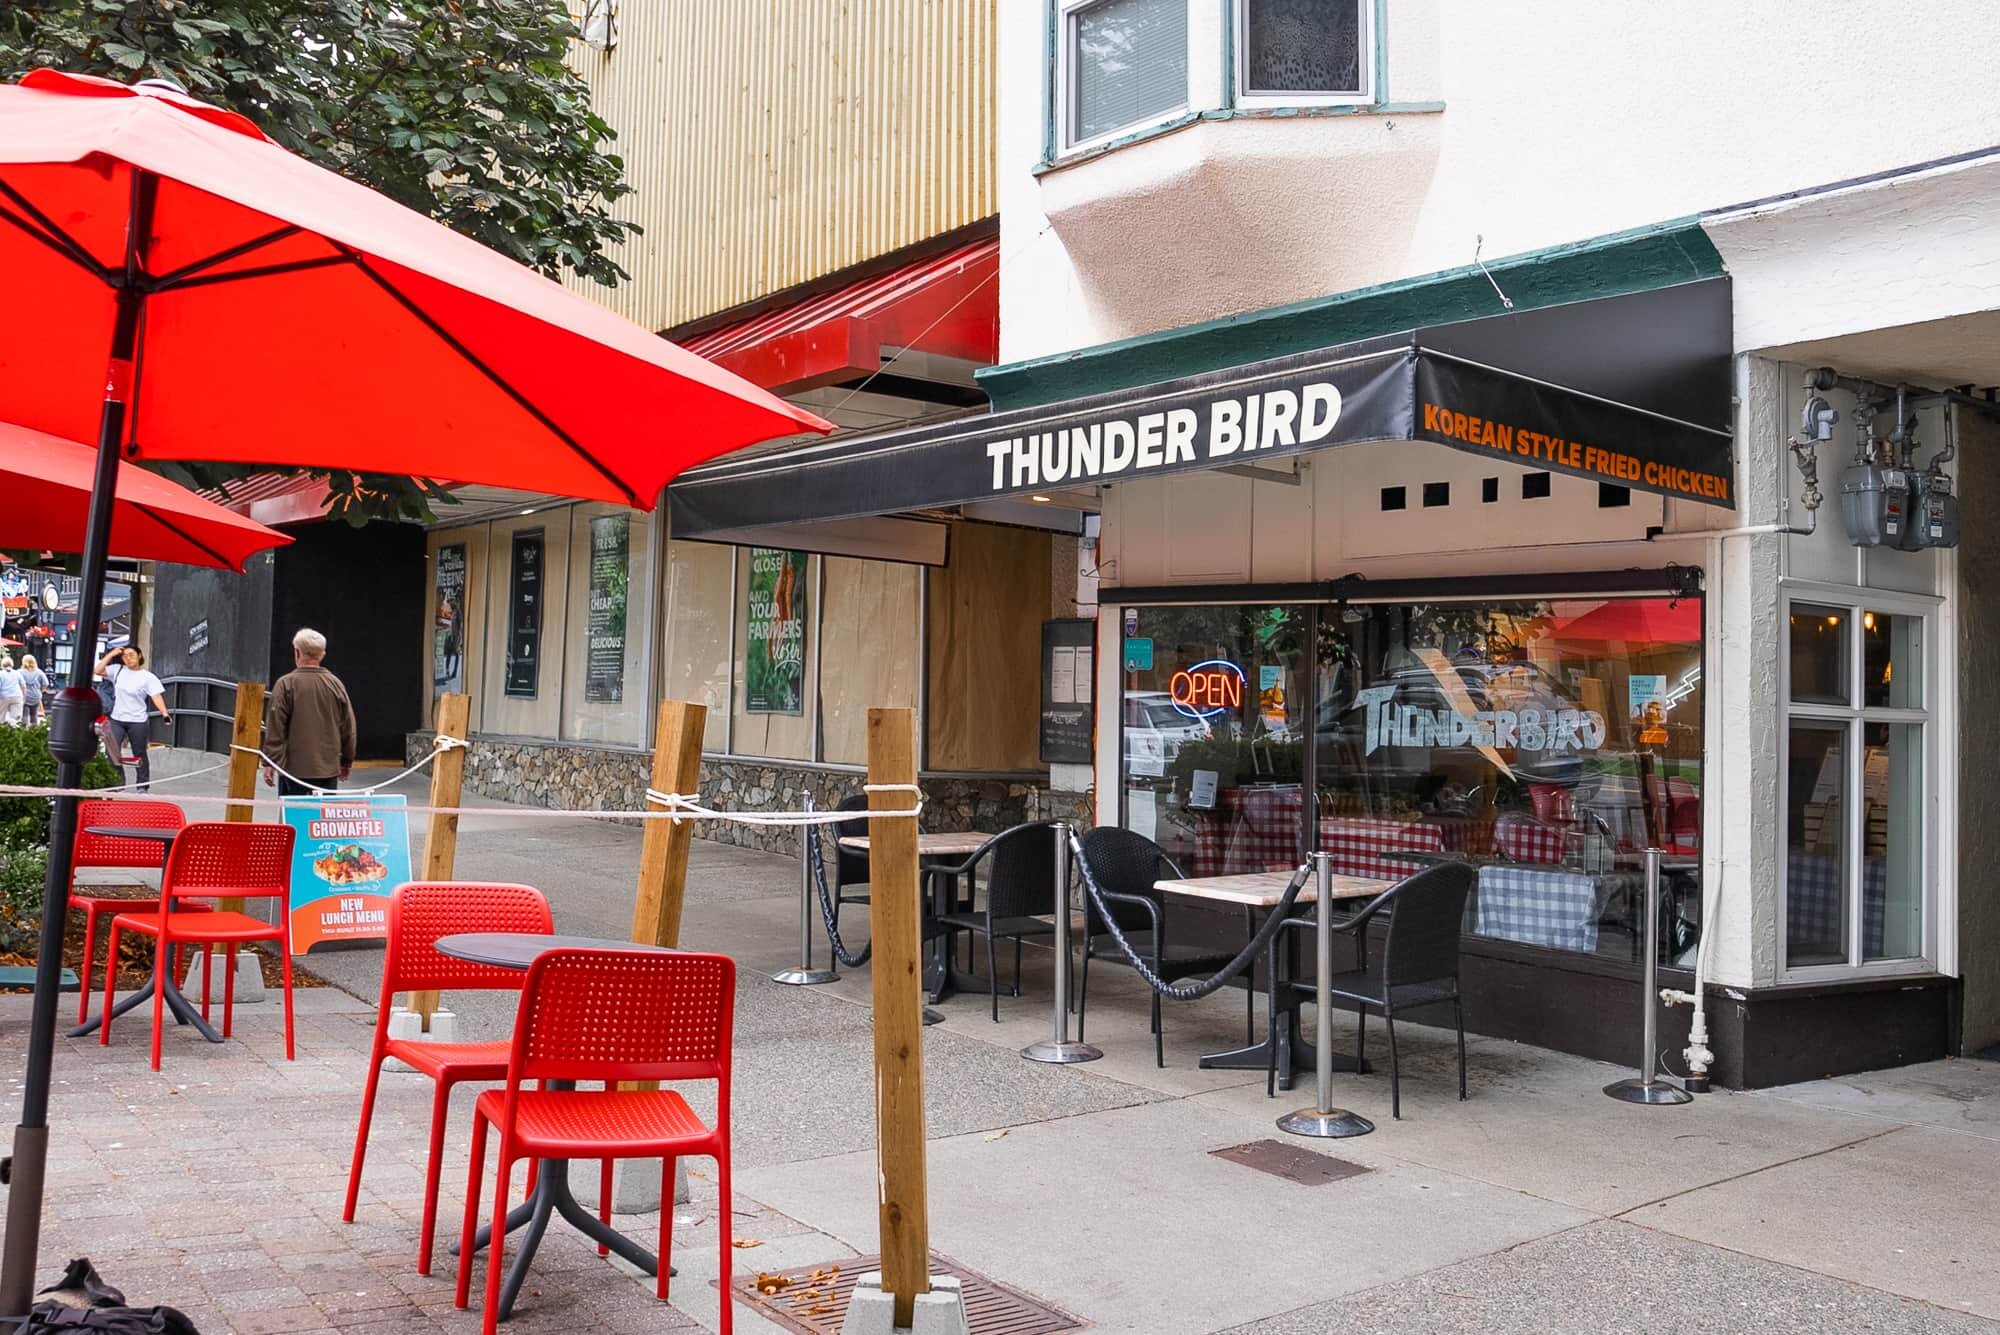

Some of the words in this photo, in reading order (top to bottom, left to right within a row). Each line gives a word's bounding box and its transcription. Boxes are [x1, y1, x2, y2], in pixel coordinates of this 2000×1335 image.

[986, 408, 1198, 490] THUNDER
[1208, 382, 1343, 458] BIRD
[1424, 403, 1513, 450] KOREAN
[1516, 429, 1582, 470] STYLE
[1585, 447, 1641, 481] FRIED
[1644, 461, 1728, 499] CHICKEN
[750, 590, 770, 602] AND
[751, 602, 781, 619] YOUR
[748, 618, 802, 641] FARMERS
[1170, 671, 1241, 707] OPEN
[1350, 684, 1607, 757] THUNDERBIRD
[324, 806, 368, 819] MEGAN
[311, 820, 382, 838] CROWAFFLE
[340, 897, 364, 911] NEW
[321, 911, 354, 925] LUNCH
[356, 910, 385, 923] MENU
